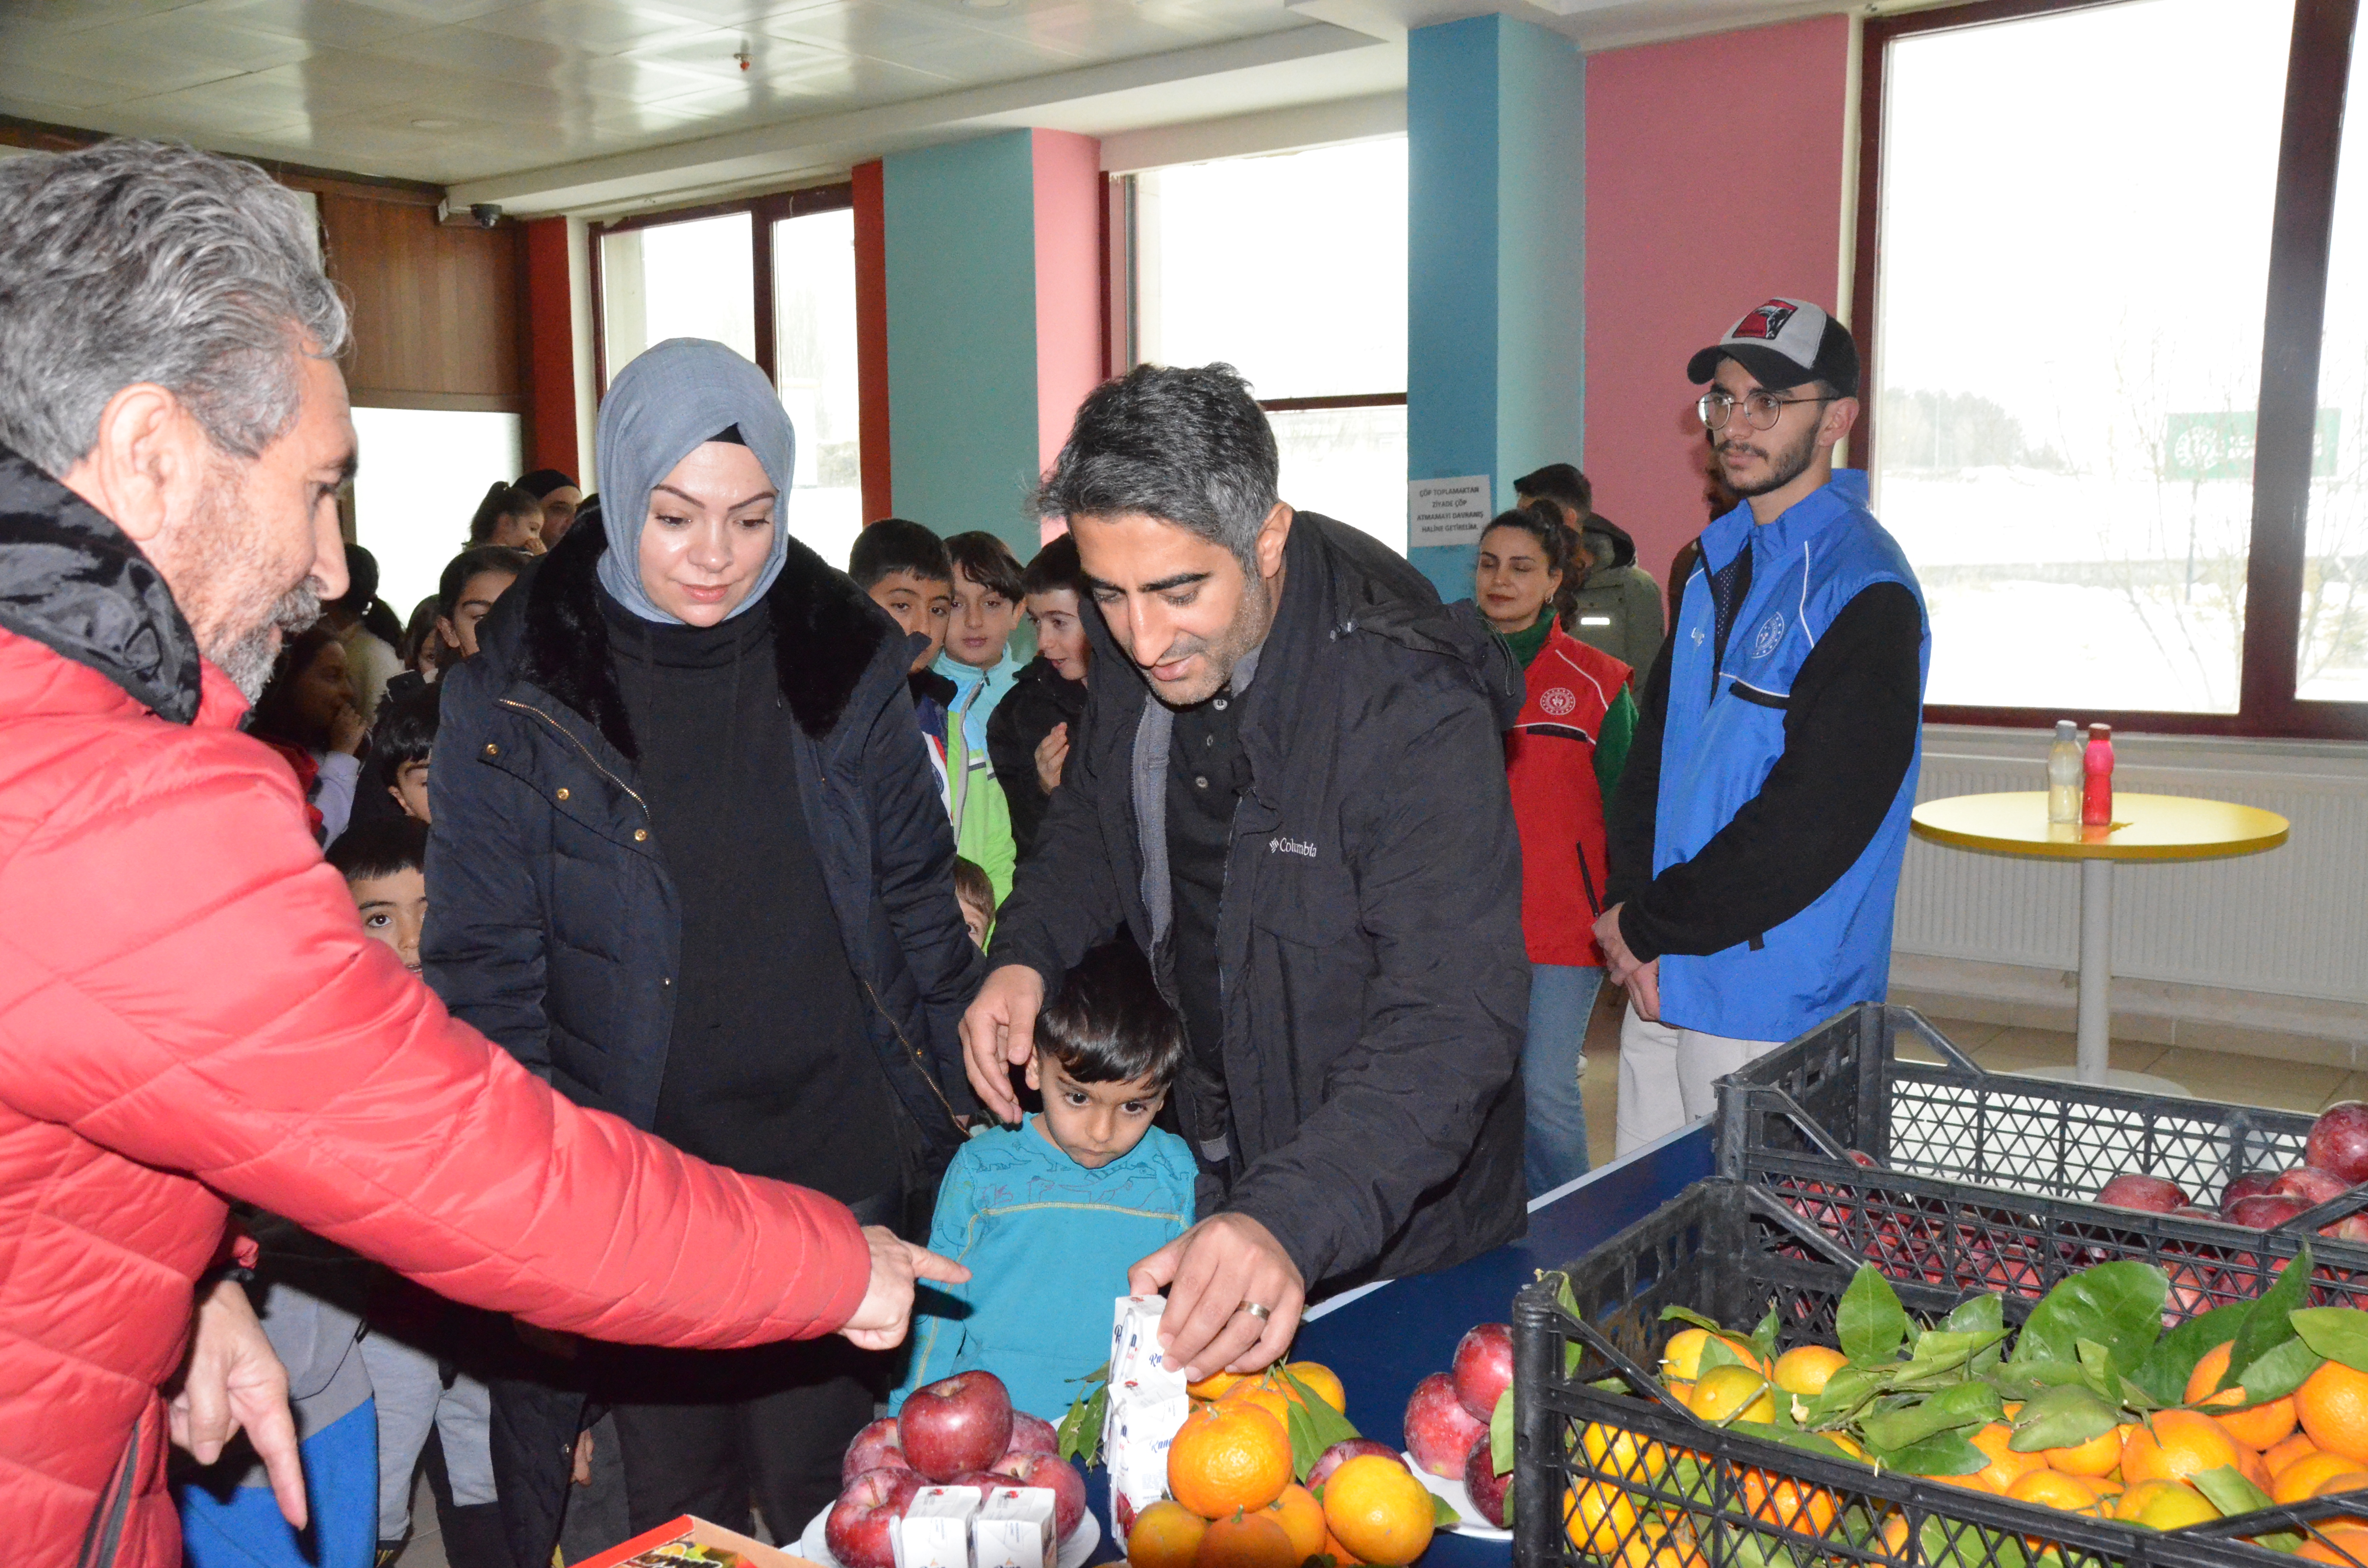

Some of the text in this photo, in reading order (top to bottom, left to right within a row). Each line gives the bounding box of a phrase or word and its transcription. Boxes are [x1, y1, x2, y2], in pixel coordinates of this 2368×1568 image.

[1420, 487, 1479, 497] ÇÖP TOPLAMAKTAN
[1455, 499, 1467, 507] ÇÖP
[1280, 837, 1317, 857] Columbia
